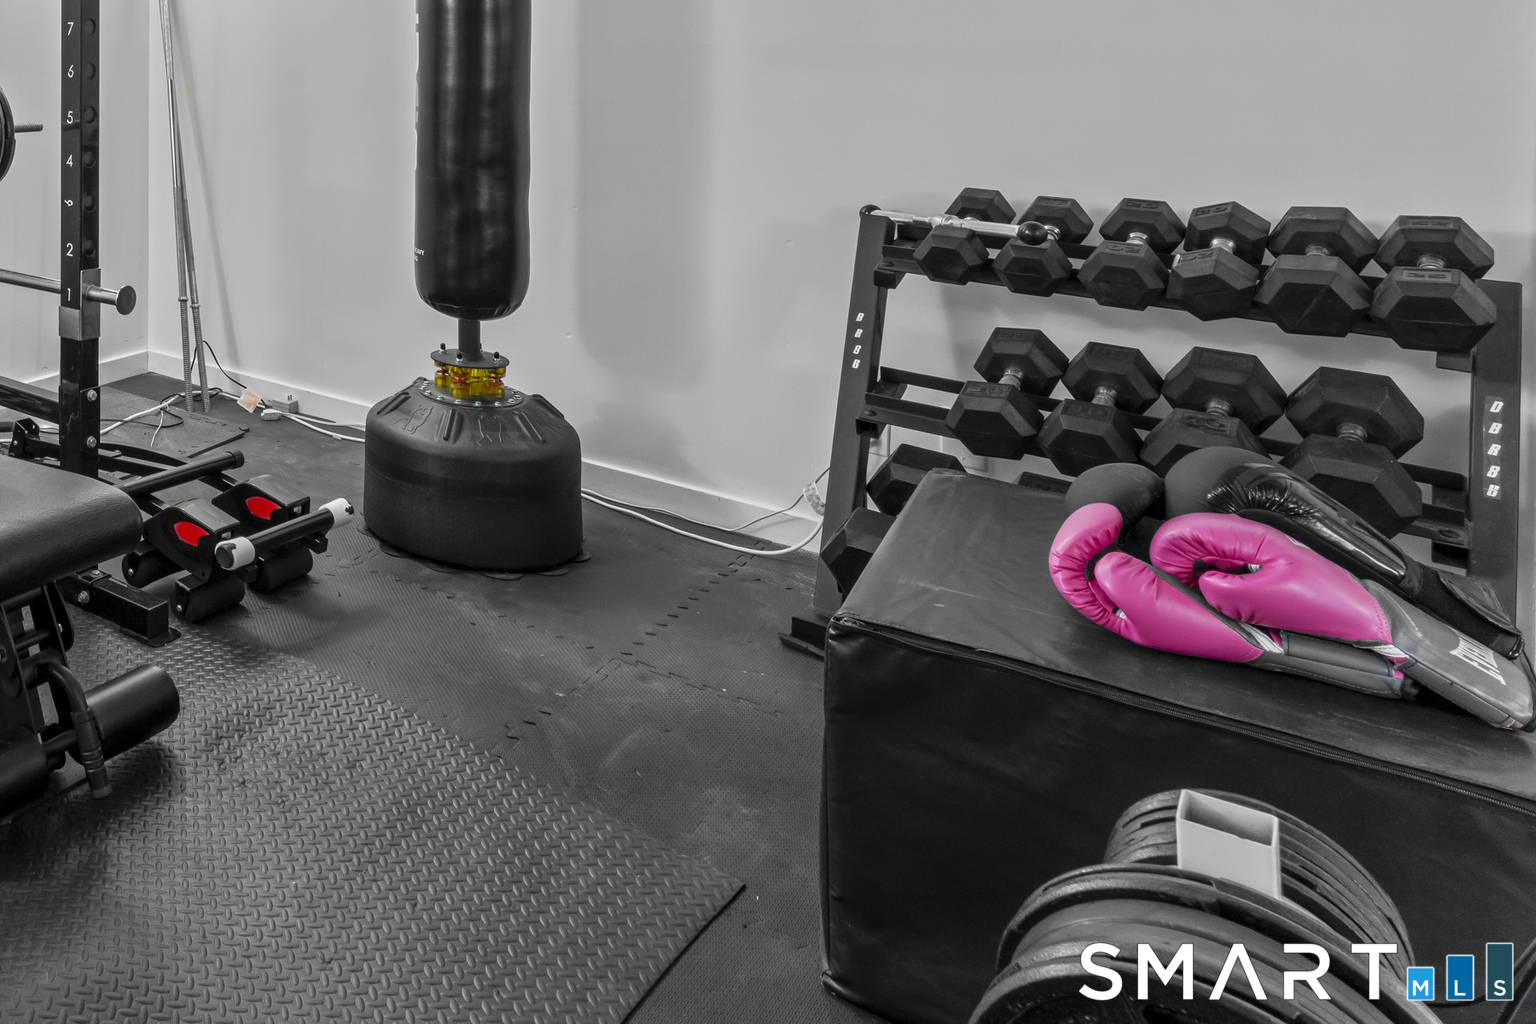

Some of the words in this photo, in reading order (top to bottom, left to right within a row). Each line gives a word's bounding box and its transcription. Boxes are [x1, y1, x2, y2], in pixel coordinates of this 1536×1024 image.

[67, 21, 75, 36] 7
[67, 64, 75, 78] 6
[66, 110, 74, 125] 5
[66, 154, 73, 168] 4
[66, 242, 74, 257] 2
[67, 287, 71, 302] 1
